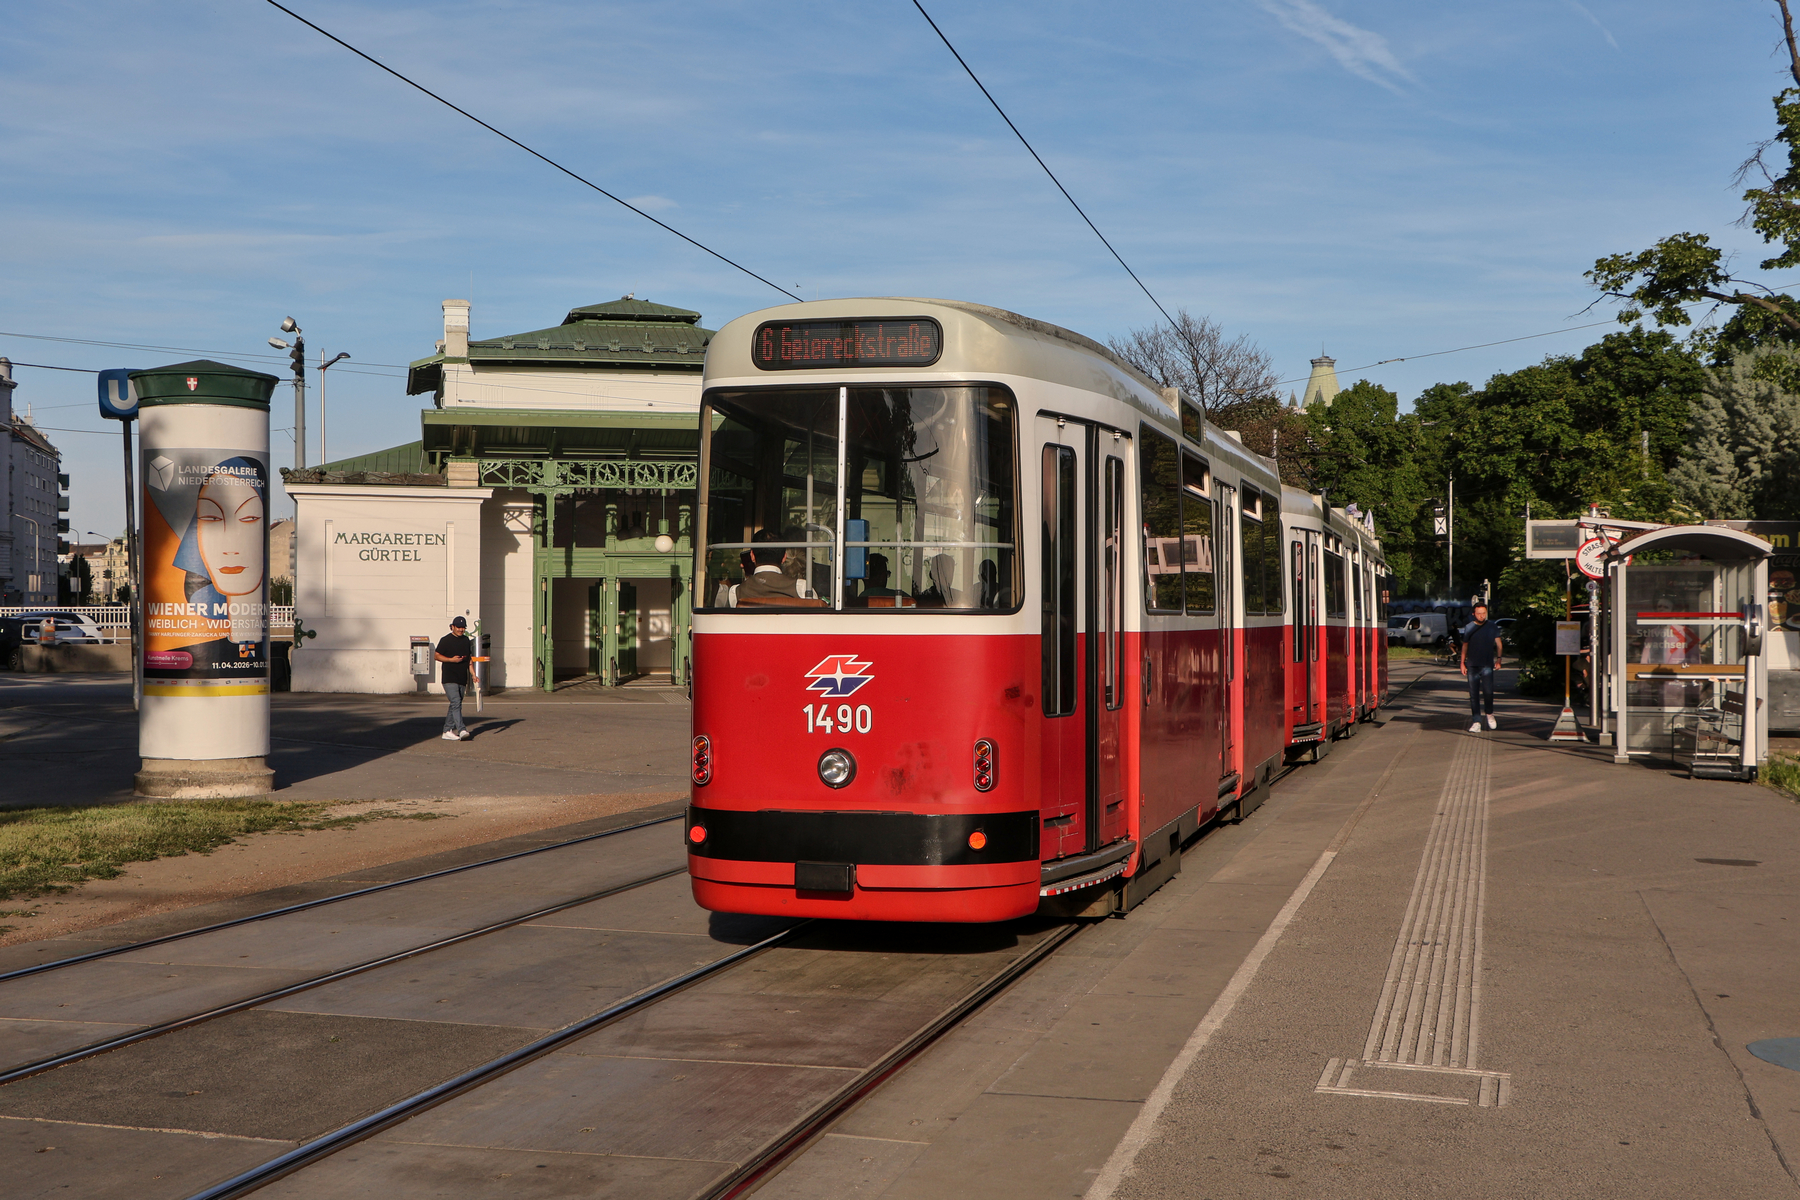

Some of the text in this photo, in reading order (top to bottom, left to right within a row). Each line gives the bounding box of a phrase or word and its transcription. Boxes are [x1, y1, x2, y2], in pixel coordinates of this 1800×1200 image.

[762, 323, 931, 361] 6 Geiereckstraße
[107, 379, 139, 411] U
[178, 465, 258, 476] LANDESGALERIE
[178, 475, 265, 488] NIEDERÖSTERREICH
[334, 532, 446, 546] MARGARETEN
[358, 547, 422, 562] GÜRTEL
[147, 602, 208, 616] WIENER
[148, 618, 198, 629] WEIBLICH
[1636, 628, 1674, 638] Stilvoll
[1644, 640, 1688, 649] wachsen
[802, 703, 873, 734] 1490
